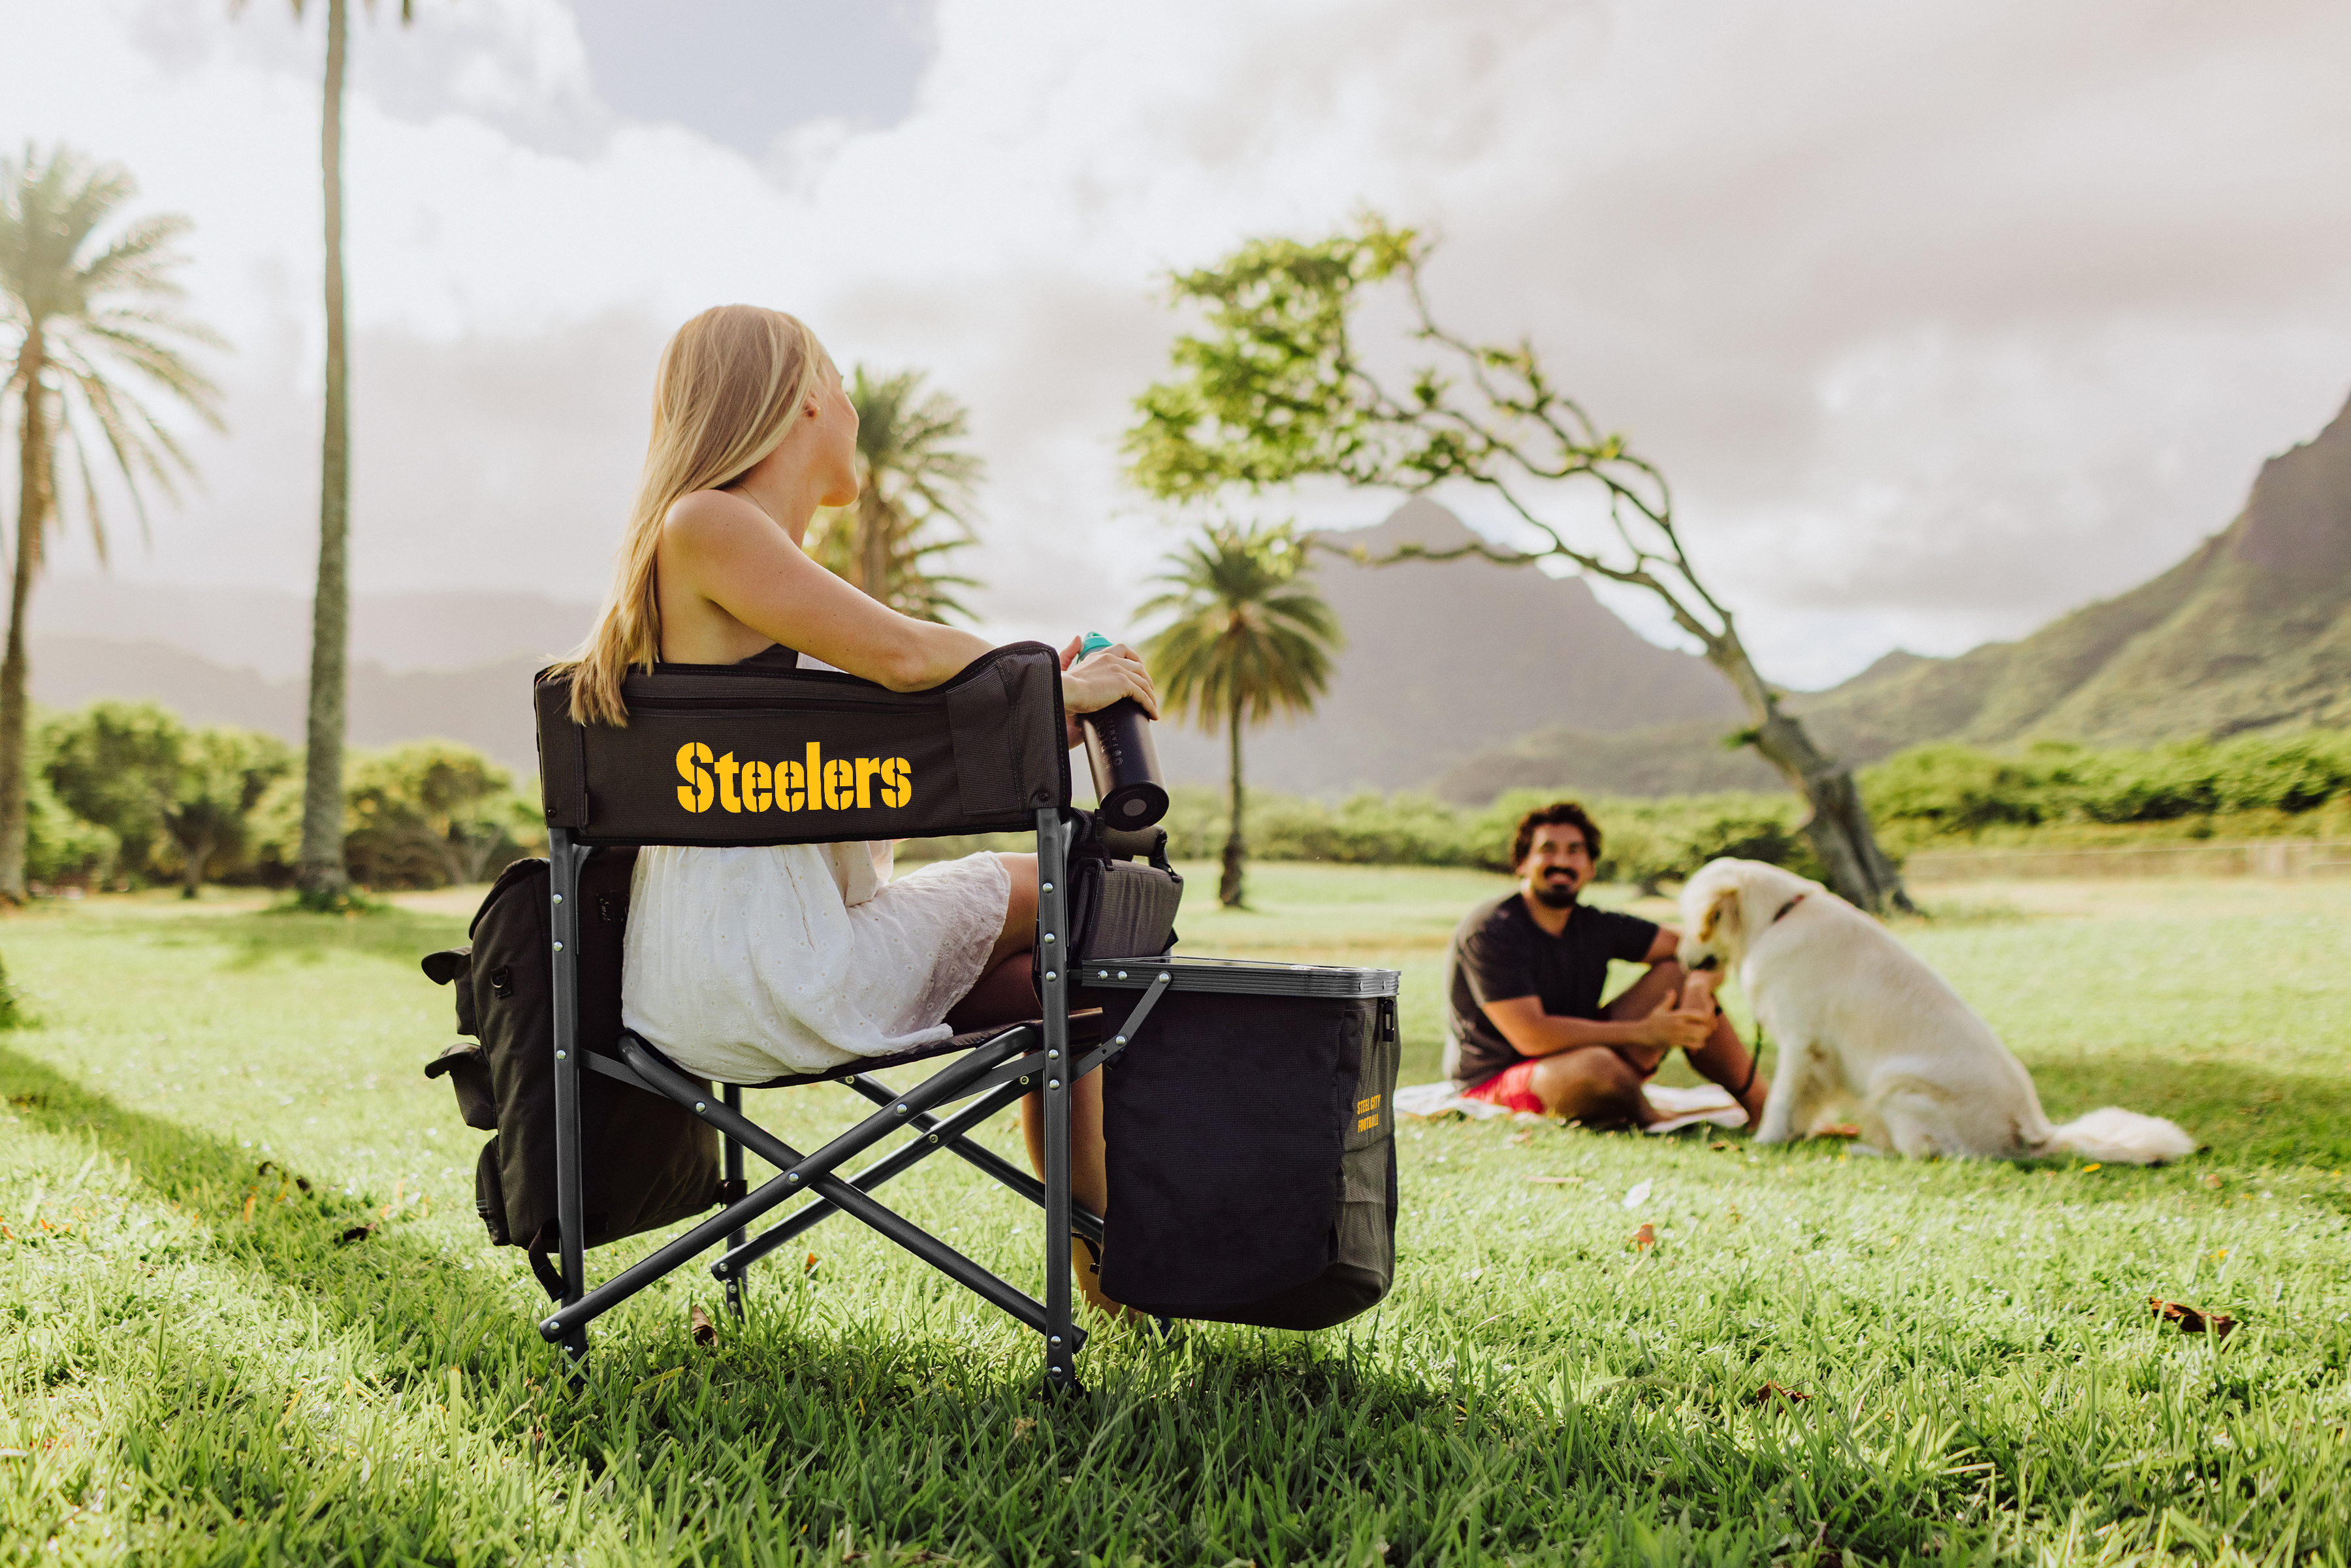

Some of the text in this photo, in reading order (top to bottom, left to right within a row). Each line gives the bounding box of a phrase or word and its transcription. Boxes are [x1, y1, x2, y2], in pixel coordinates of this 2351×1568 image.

[675, 742, 912, 813] Steelers
[1357, 1094, 1381, 1115] STEEL CITY
[1358, 1113, 1379, 1132] FOOTBALL
